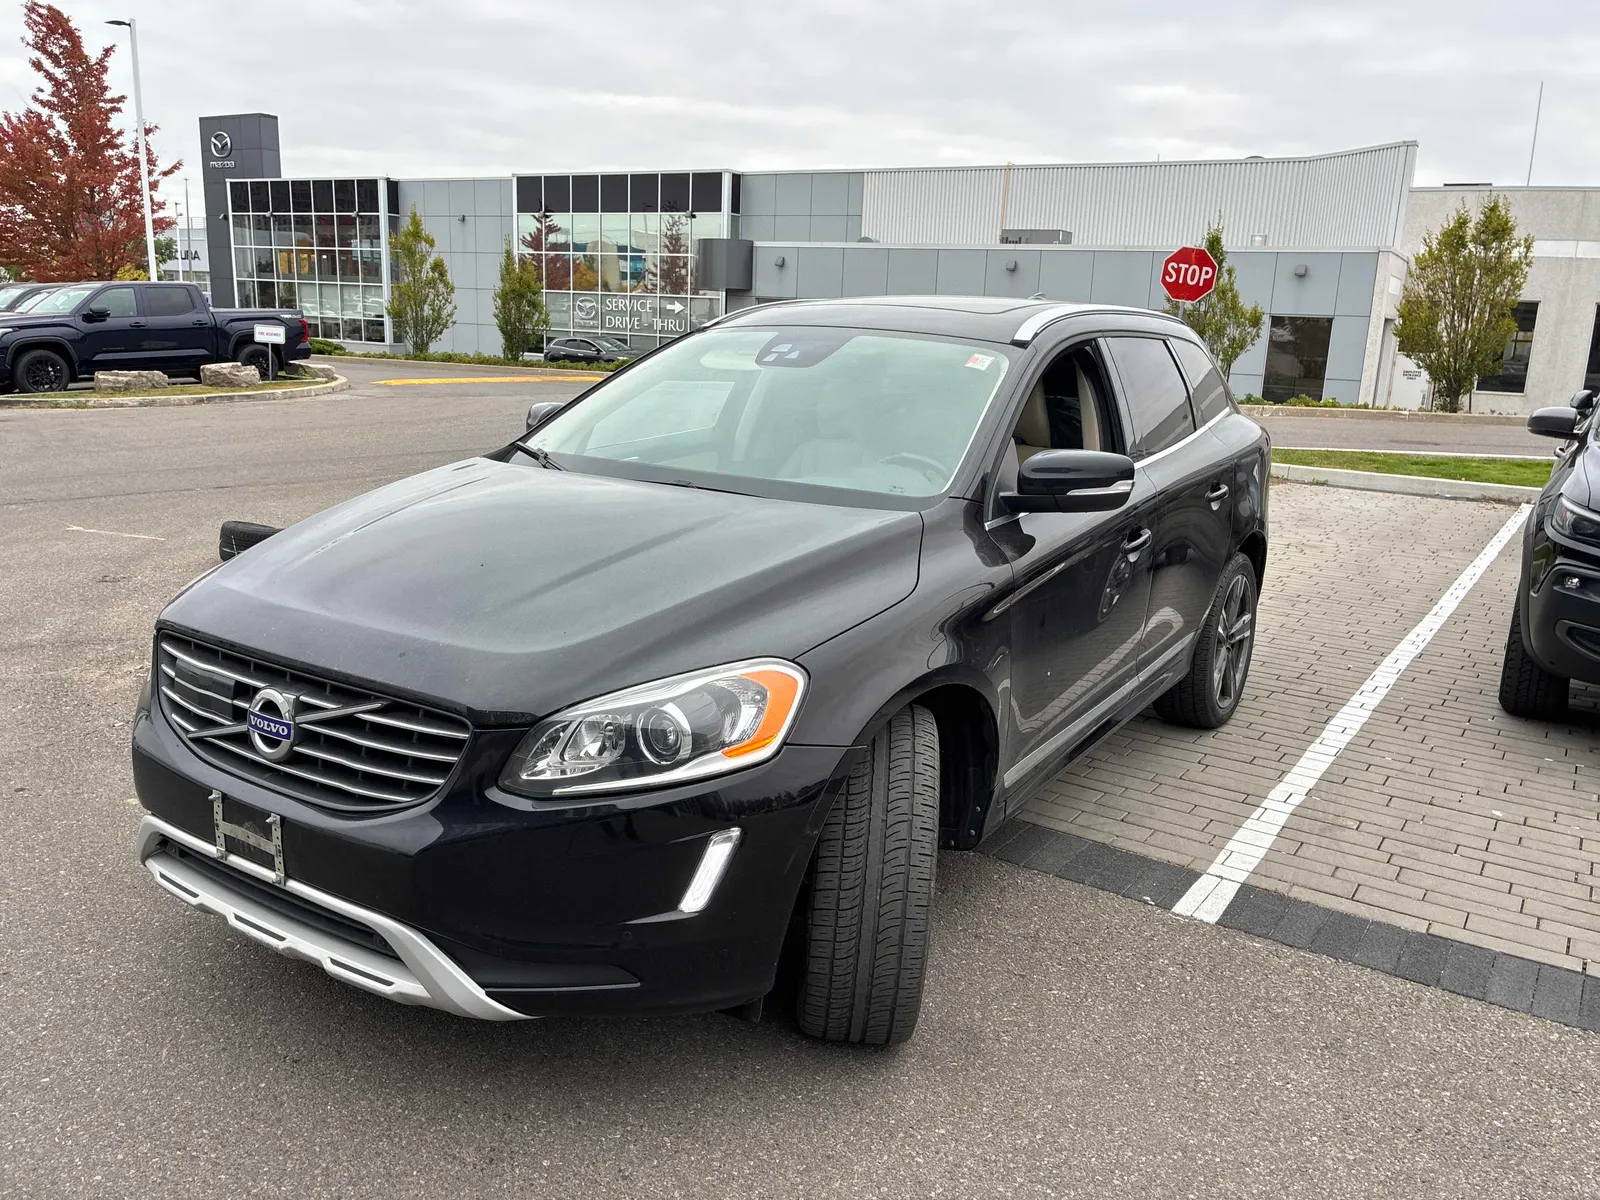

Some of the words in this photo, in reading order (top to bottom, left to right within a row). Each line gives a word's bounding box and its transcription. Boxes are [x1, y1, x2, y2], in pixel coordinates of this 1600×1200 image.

[1165, 262, 1213, 287] STOP
[605, 298, 653, 312] SERVICE
[605, 315, 641, 329] DRIVE
[652, 318, 685, 332] THRU
[250, 714, 288, 735] VOLVO
